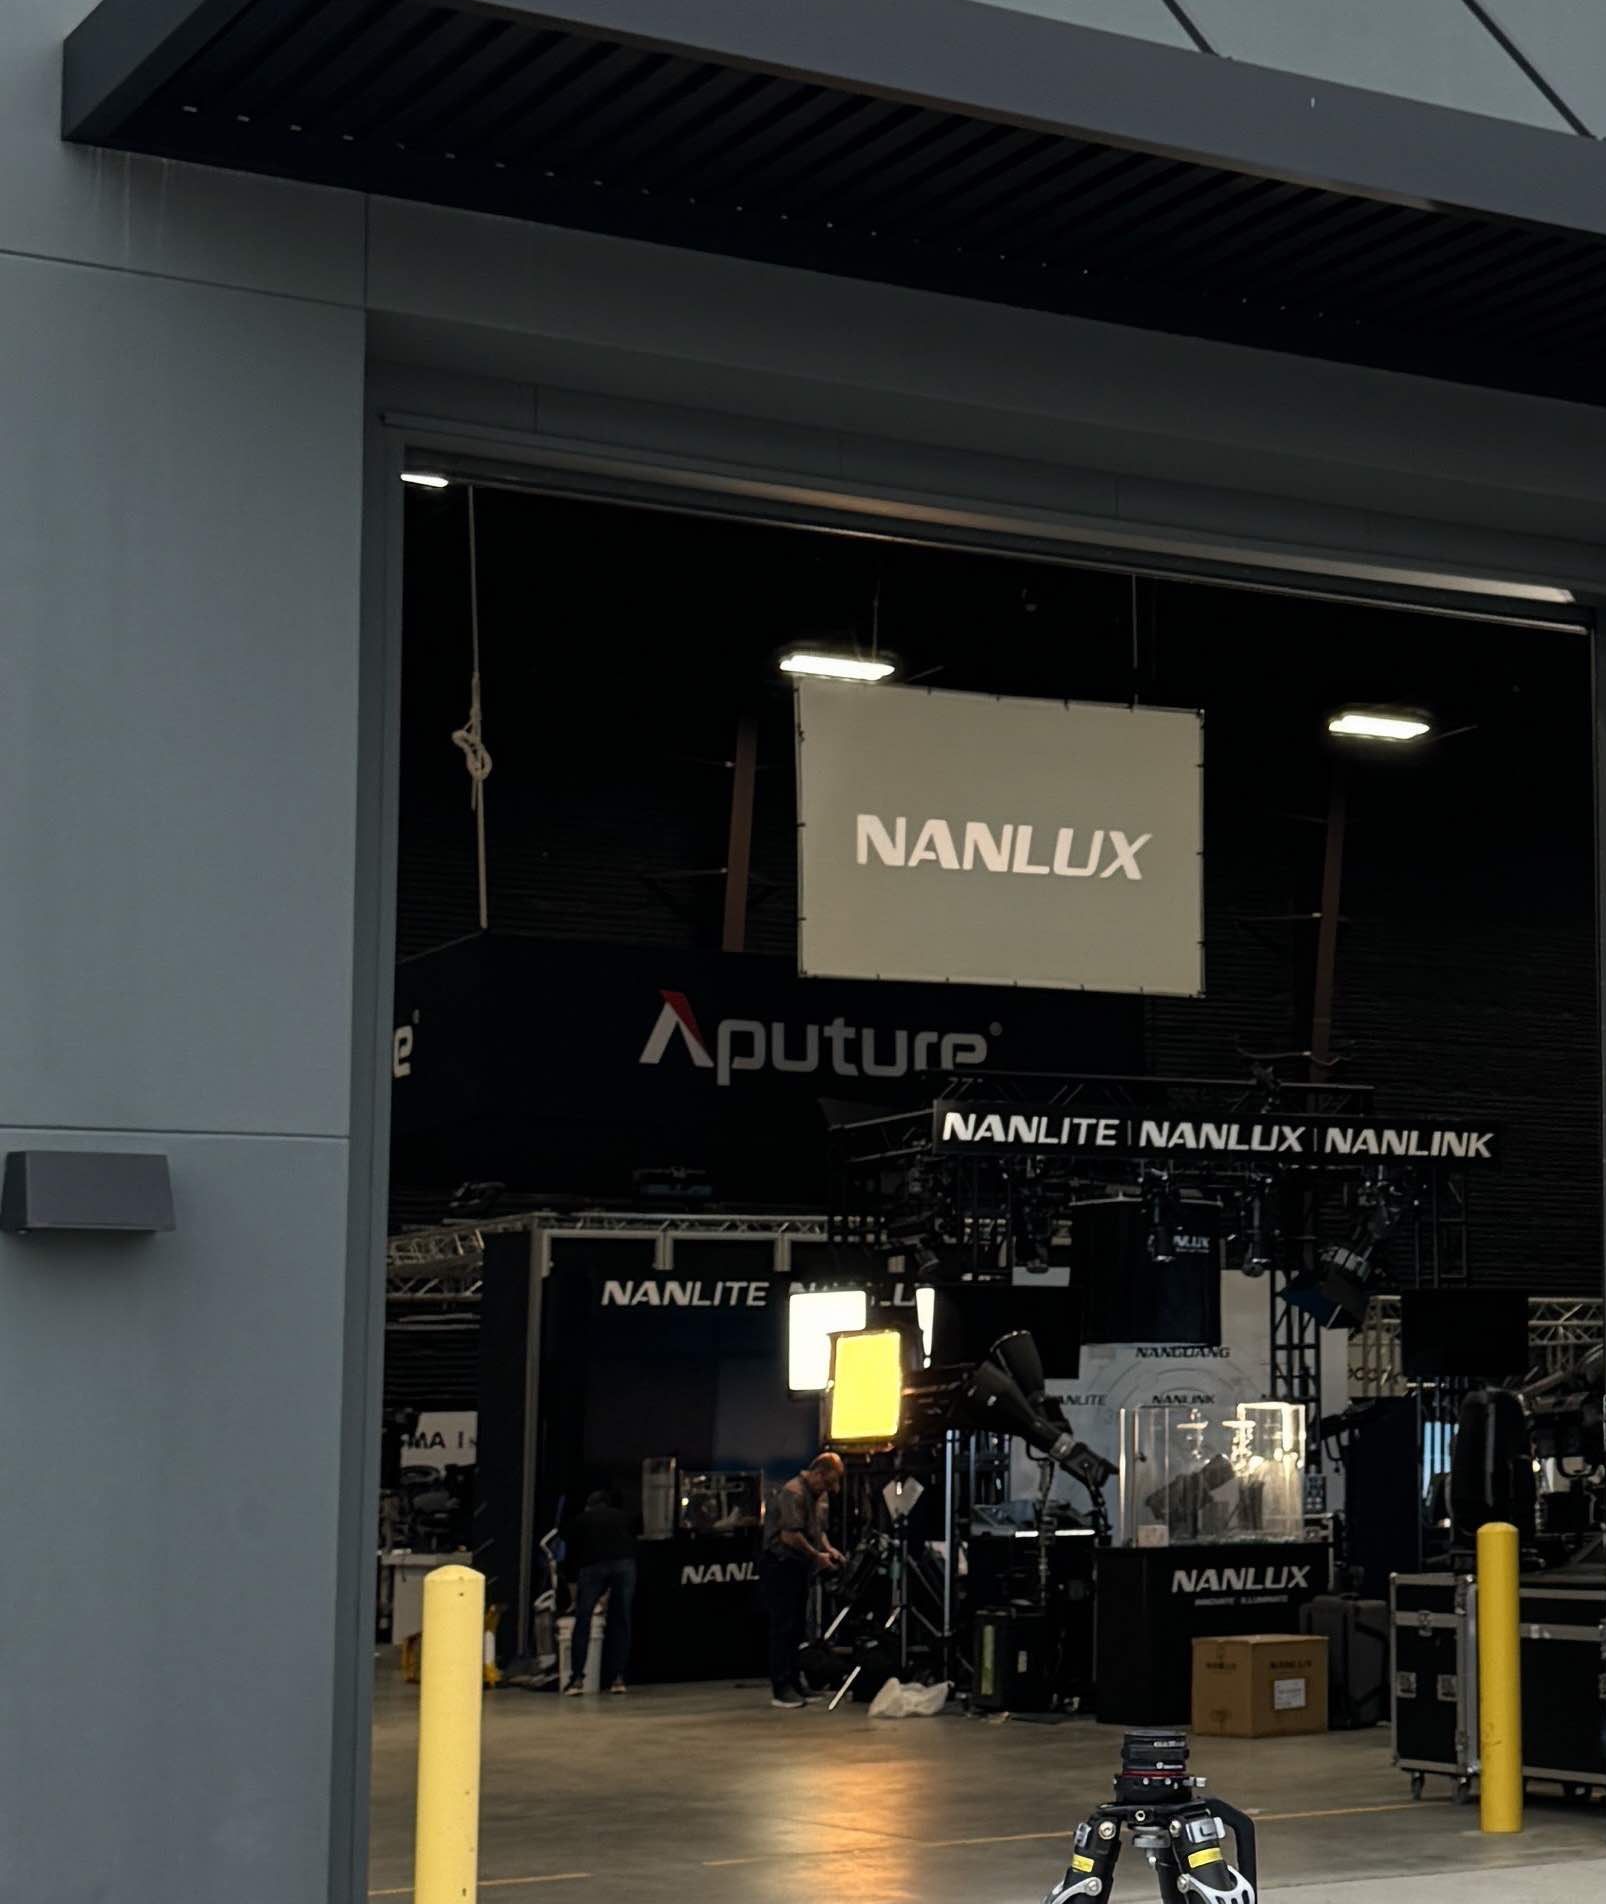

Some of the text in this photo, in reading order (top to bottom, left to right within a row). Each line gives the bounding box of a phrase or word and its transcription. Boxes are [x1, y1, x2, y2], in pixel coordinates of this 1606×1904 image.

[856, 813, 1153, 881] NANLUX
[639, 989, 988, 1086] Aputure
[942, 1111, 1495, 1159] NANLITE NANLUX NANLINK
[601, 1280, 770, 1307] NANLITE
[681, 1561, 760, 1585] NANL
[1171, 1565, 1312, 1594] NANLUX
